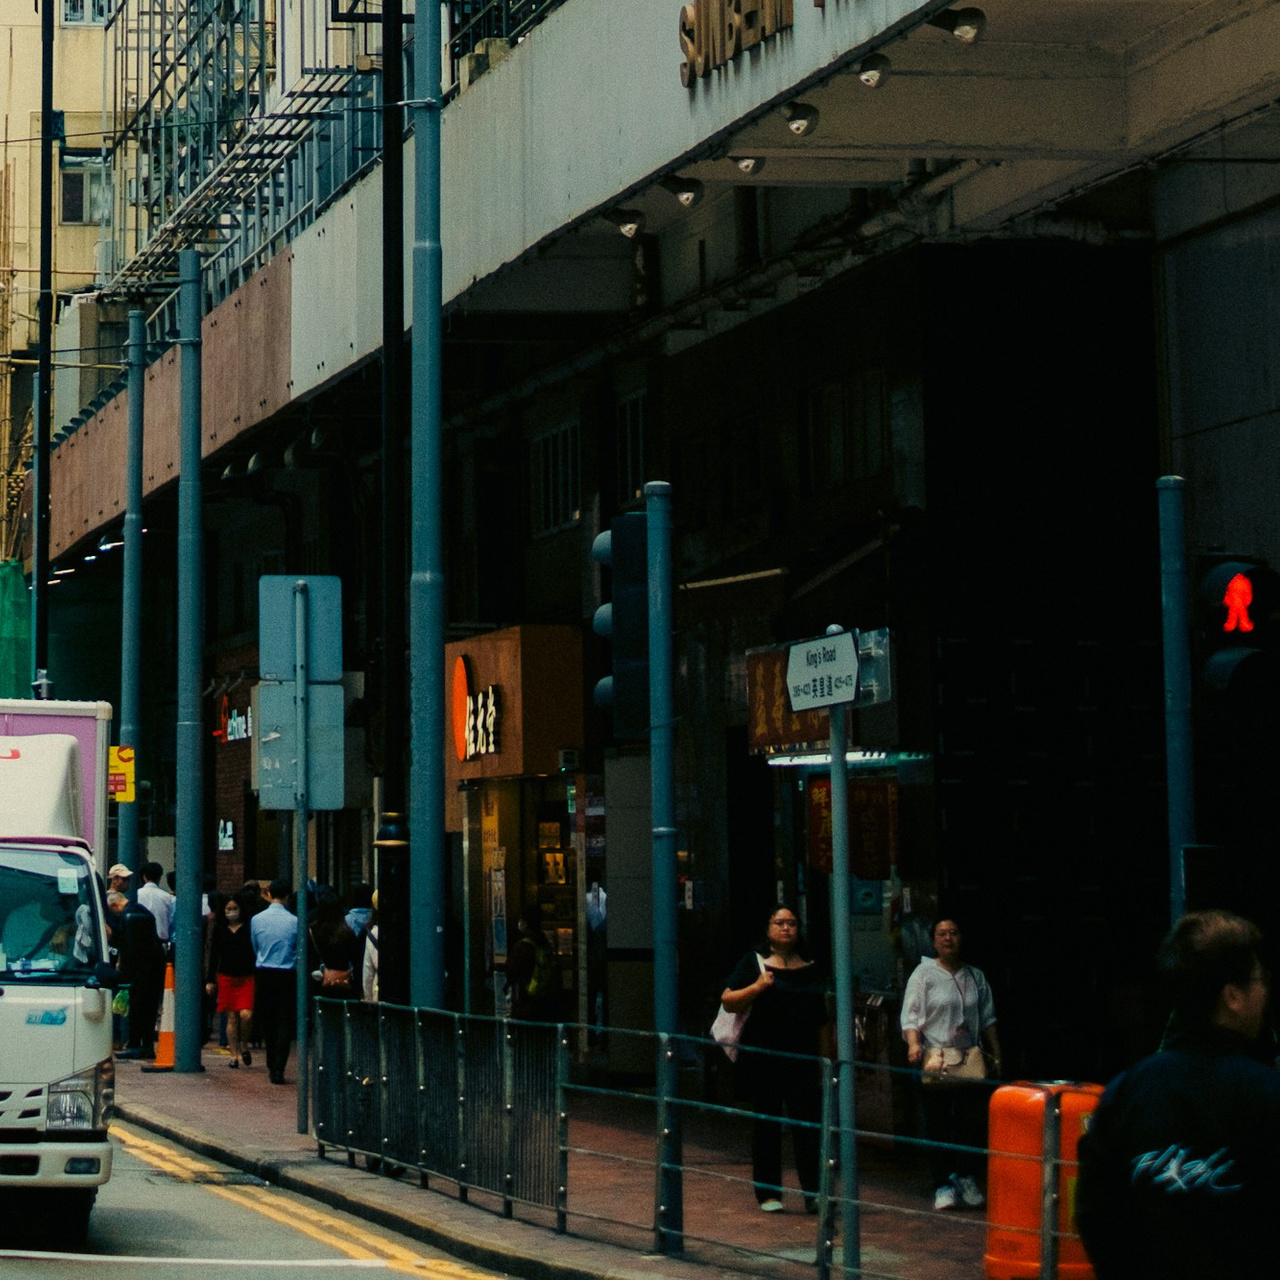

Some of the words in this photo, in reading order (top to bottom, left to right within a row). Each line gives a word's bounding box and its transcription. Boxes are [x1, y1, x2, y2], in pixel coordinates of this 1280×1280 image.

[806, 648, 822, 668] King's
[822, 644, 837, 663] Road
[811, 675, 833, 699] 英皇道
